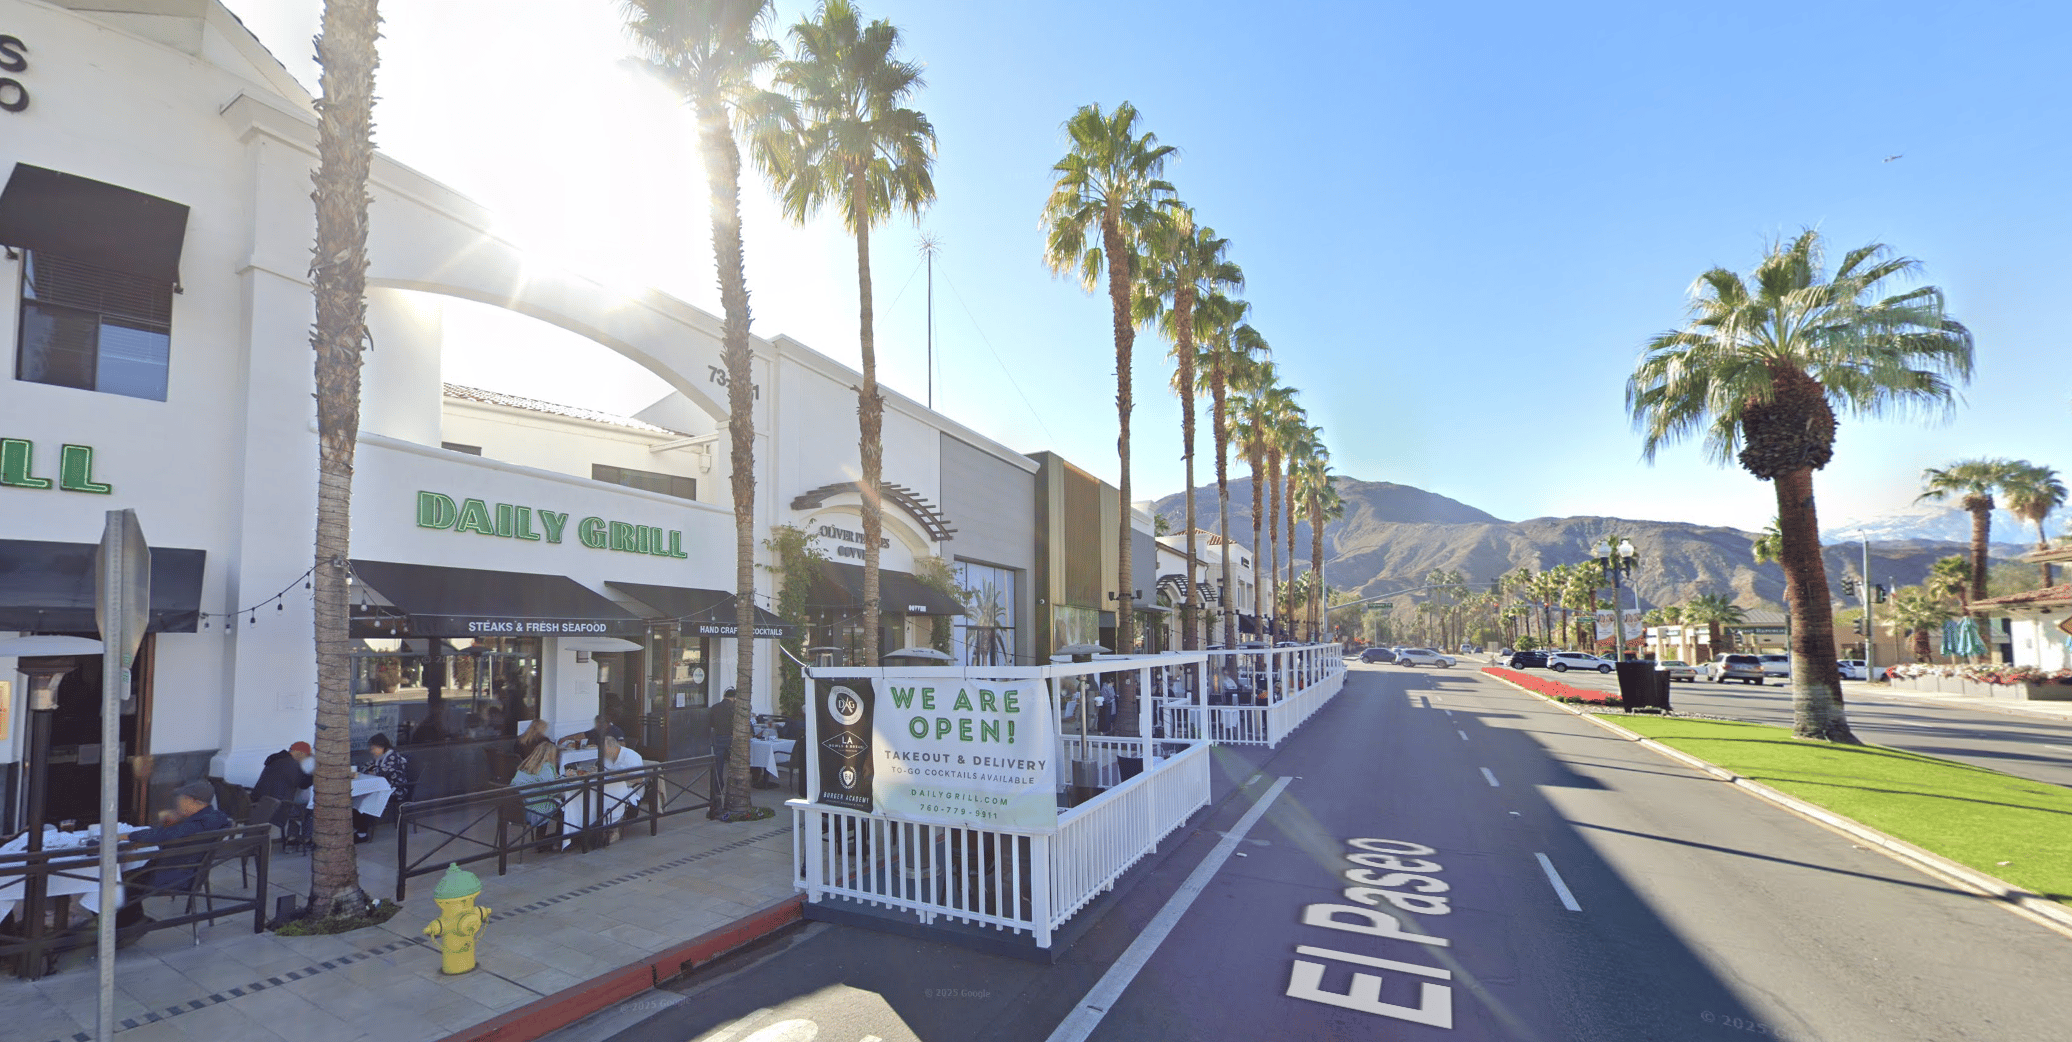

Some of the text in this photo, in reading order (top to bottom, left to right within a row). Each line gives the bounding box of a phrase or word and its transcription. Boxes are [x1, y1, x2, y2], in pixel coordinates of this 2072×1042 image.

[707, 364, 760, 401] 73-1
[417, 490, 688, 559] DAILY GRILL
[819, 524, 855, 544] OLIVER
[468, 621, 607, 632] STEAKS & FRESH SEAFOOD
[699, 625, 719, 634] HAND
[890, 686, 936, 710] WE
[953, 687, 1020, 713] ARE
[908, 715, 1015, 744] OPEN!
[841, 735, 854, 745] LA
[885, 750, 1047, 771] TAKEOUT & DELIVERY
[891, 766, 1035, 785] TO-GO COCKTAILS AVAILABLE
[910, 788, 1009, 806] DAILYGRILL.COM
[919, 803, 999, 820] 760-779-9911
